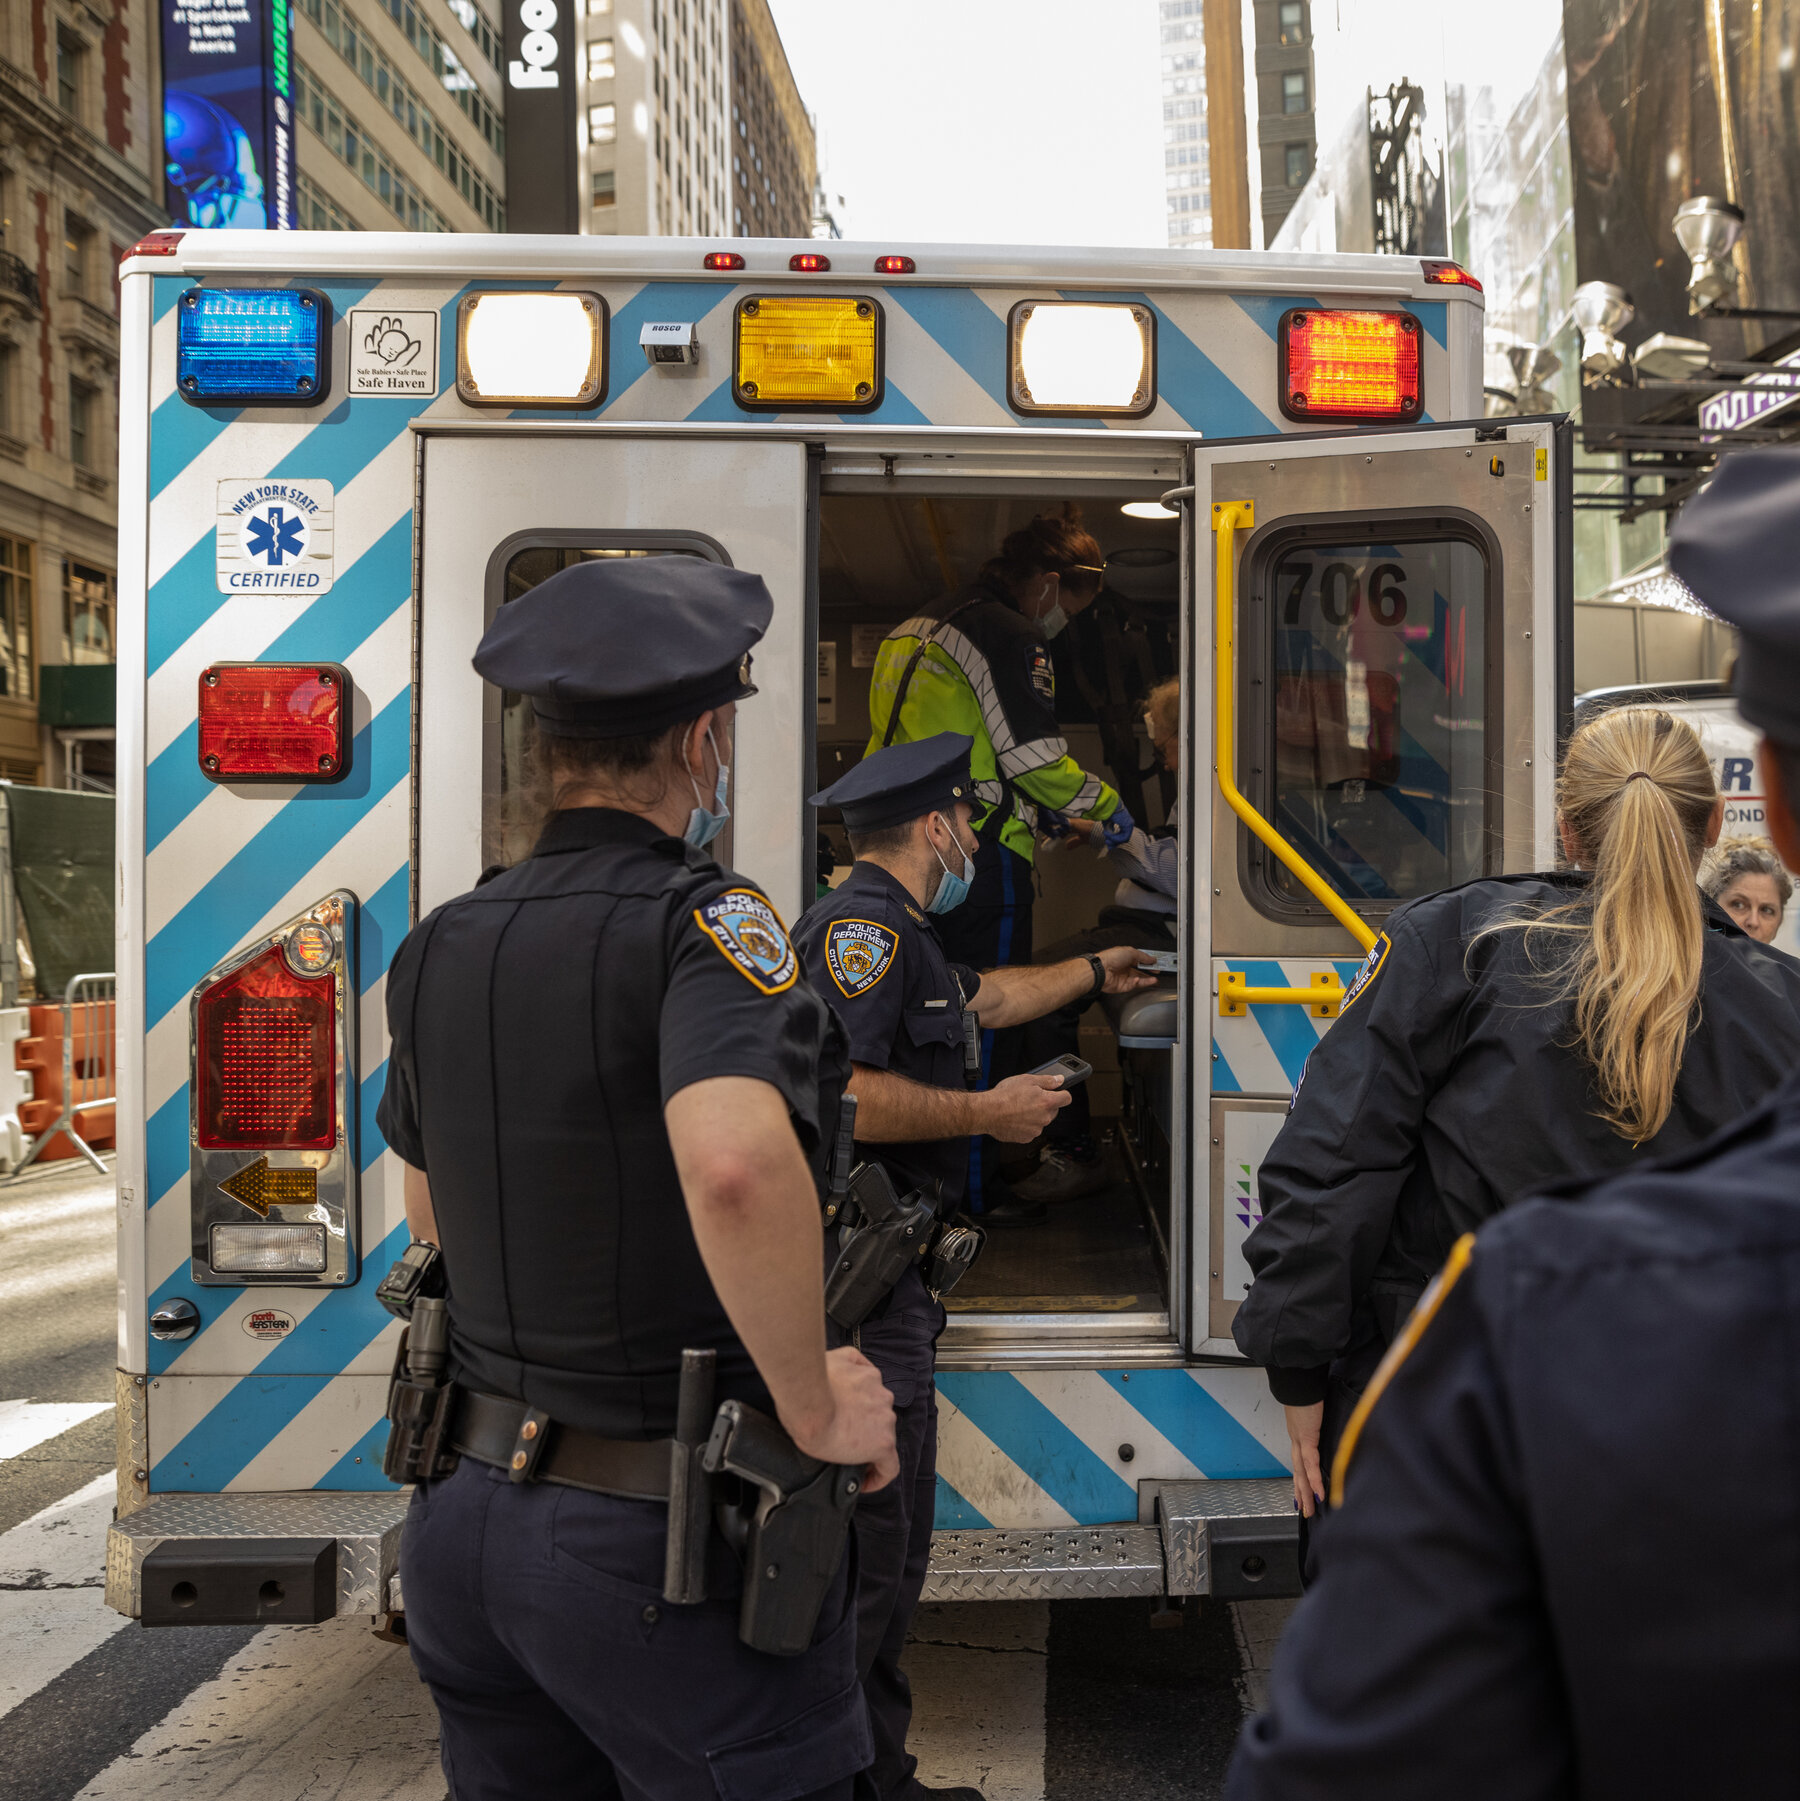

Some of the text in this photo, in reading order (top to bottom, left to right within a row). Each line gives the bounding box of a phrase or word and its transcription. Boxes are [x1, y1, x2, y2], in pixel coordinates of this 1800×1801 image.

[358, 377, 425, 388] Safe Haven
[232, 485, 319, 515] NEW YORK STATE
[230, 573, 320, 587] CERTIFIED
[1278, 562, 1408, 627] 706
[833, 931, 891, 951] DEPARTMENT
[847, 923, 882, 937] POLICE
[712, 925, 755, 969] CITY OF
[829, 949, 845, 981] CITY OF
[856, 956, 890, 990] NEW YORK
[1351, 971, 1372, 996] YORK
[253, 1320, 289, 1329] EASTERN
